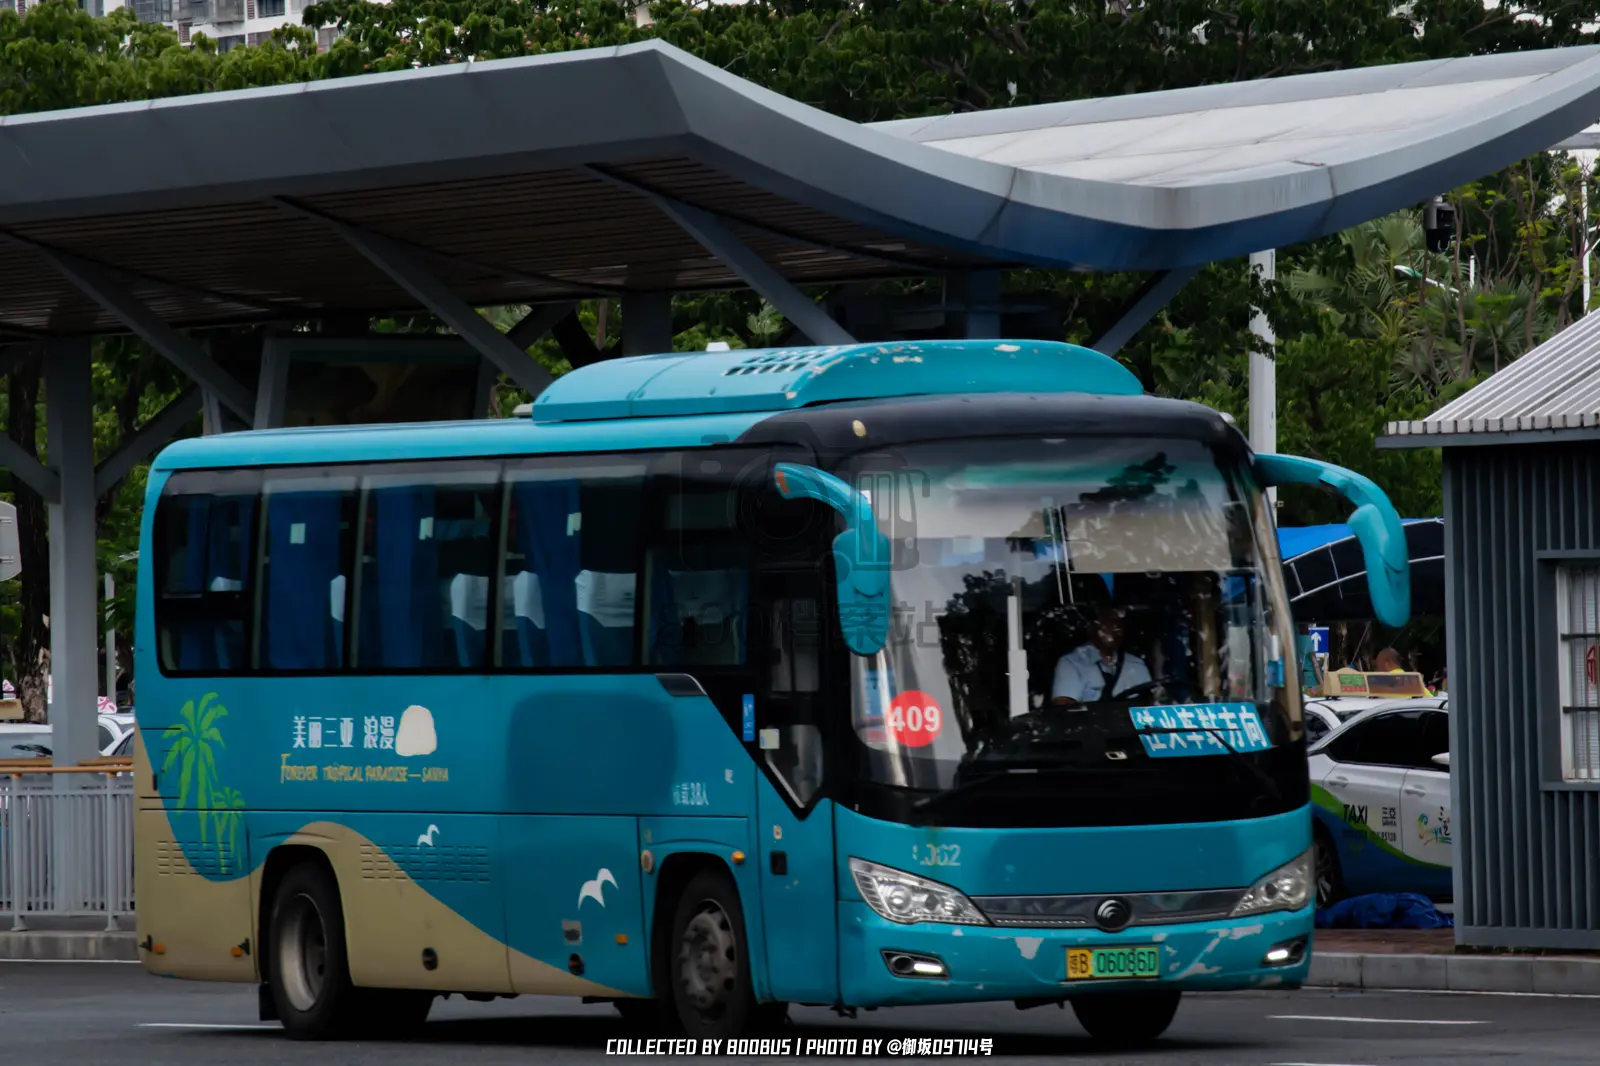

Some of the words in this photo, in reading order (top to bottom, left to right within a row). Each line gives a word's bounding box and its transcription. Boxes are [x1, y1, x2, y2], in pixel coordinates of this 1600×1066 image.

[293, 715, 354, 749] 美丽三亚
[888, 705, 941, 733] 409
[1343, 804, 1368, 825] TAXI
